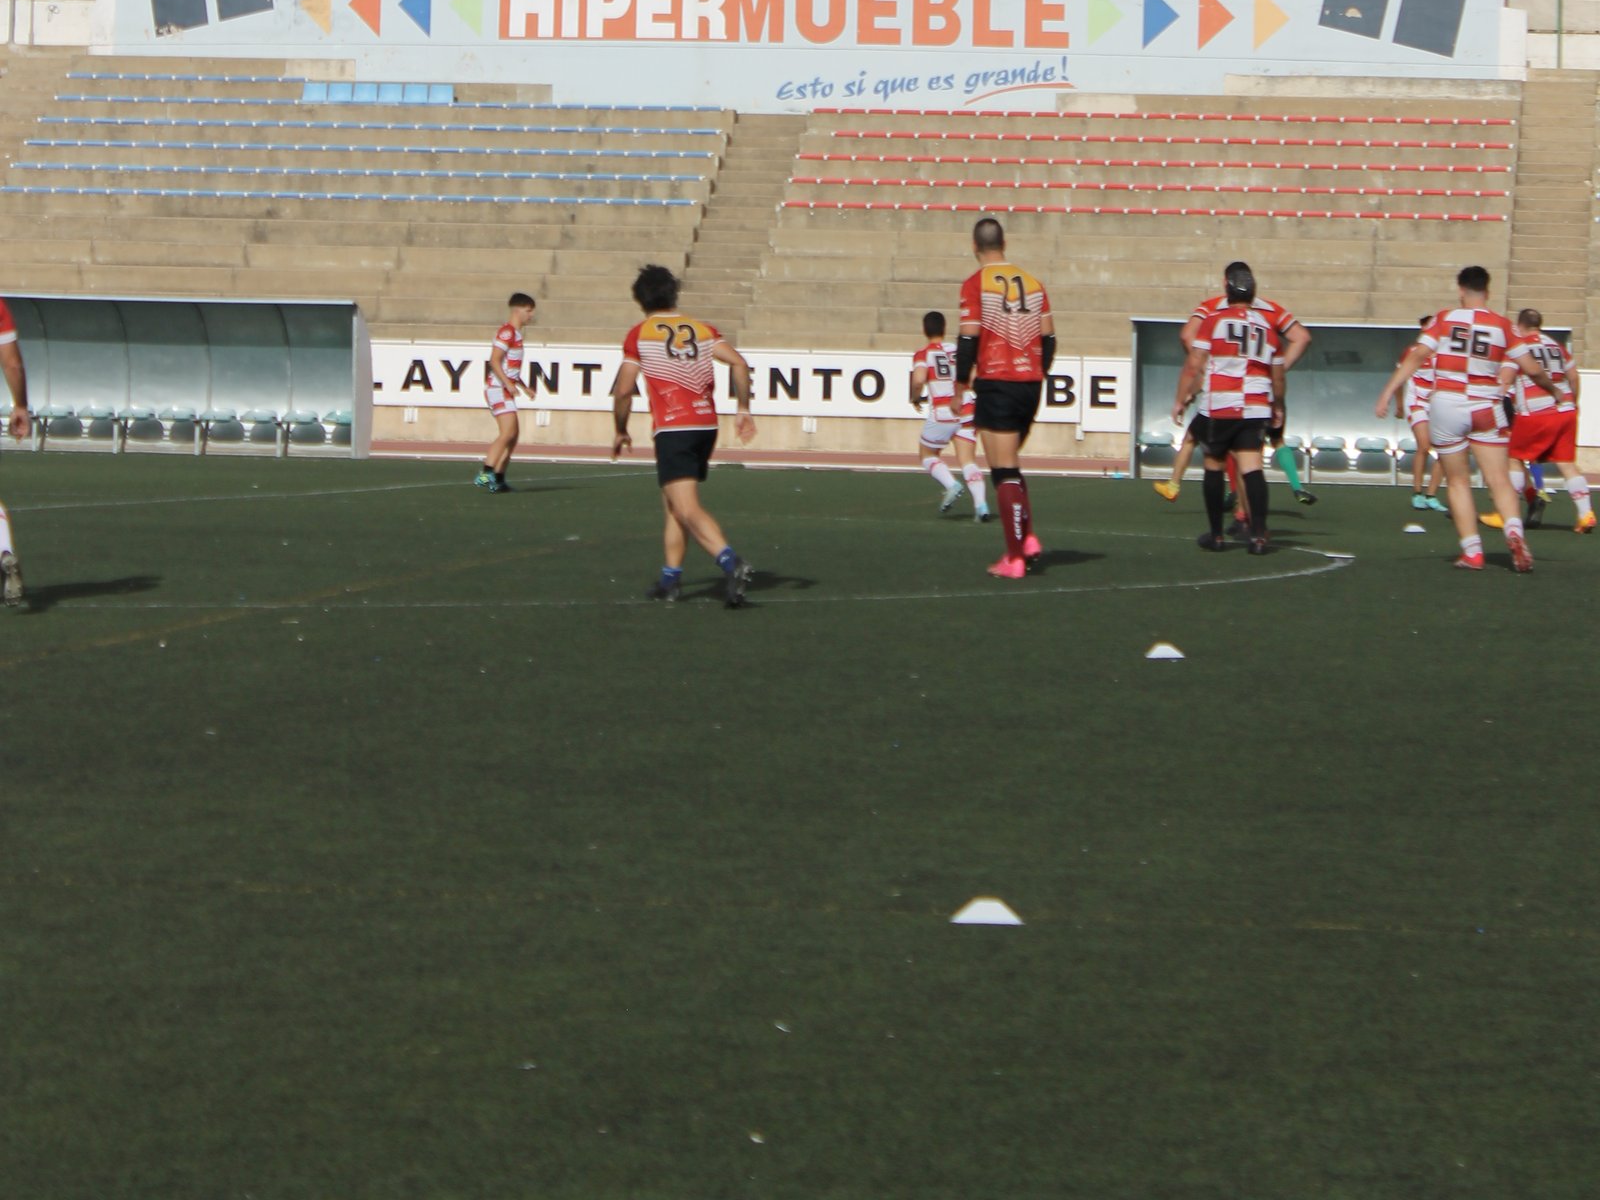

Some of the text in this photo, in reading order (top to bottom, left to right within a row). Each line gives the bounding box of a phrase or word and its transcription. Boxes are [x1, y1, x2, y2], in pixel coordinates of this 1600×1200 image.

[776, 55, 1070, 102] Esto si que es grande!
[995, 275, 1030, 314] 21
[656, 323, 699, 361] 23
[1450, 326, 1491, 358] 56
